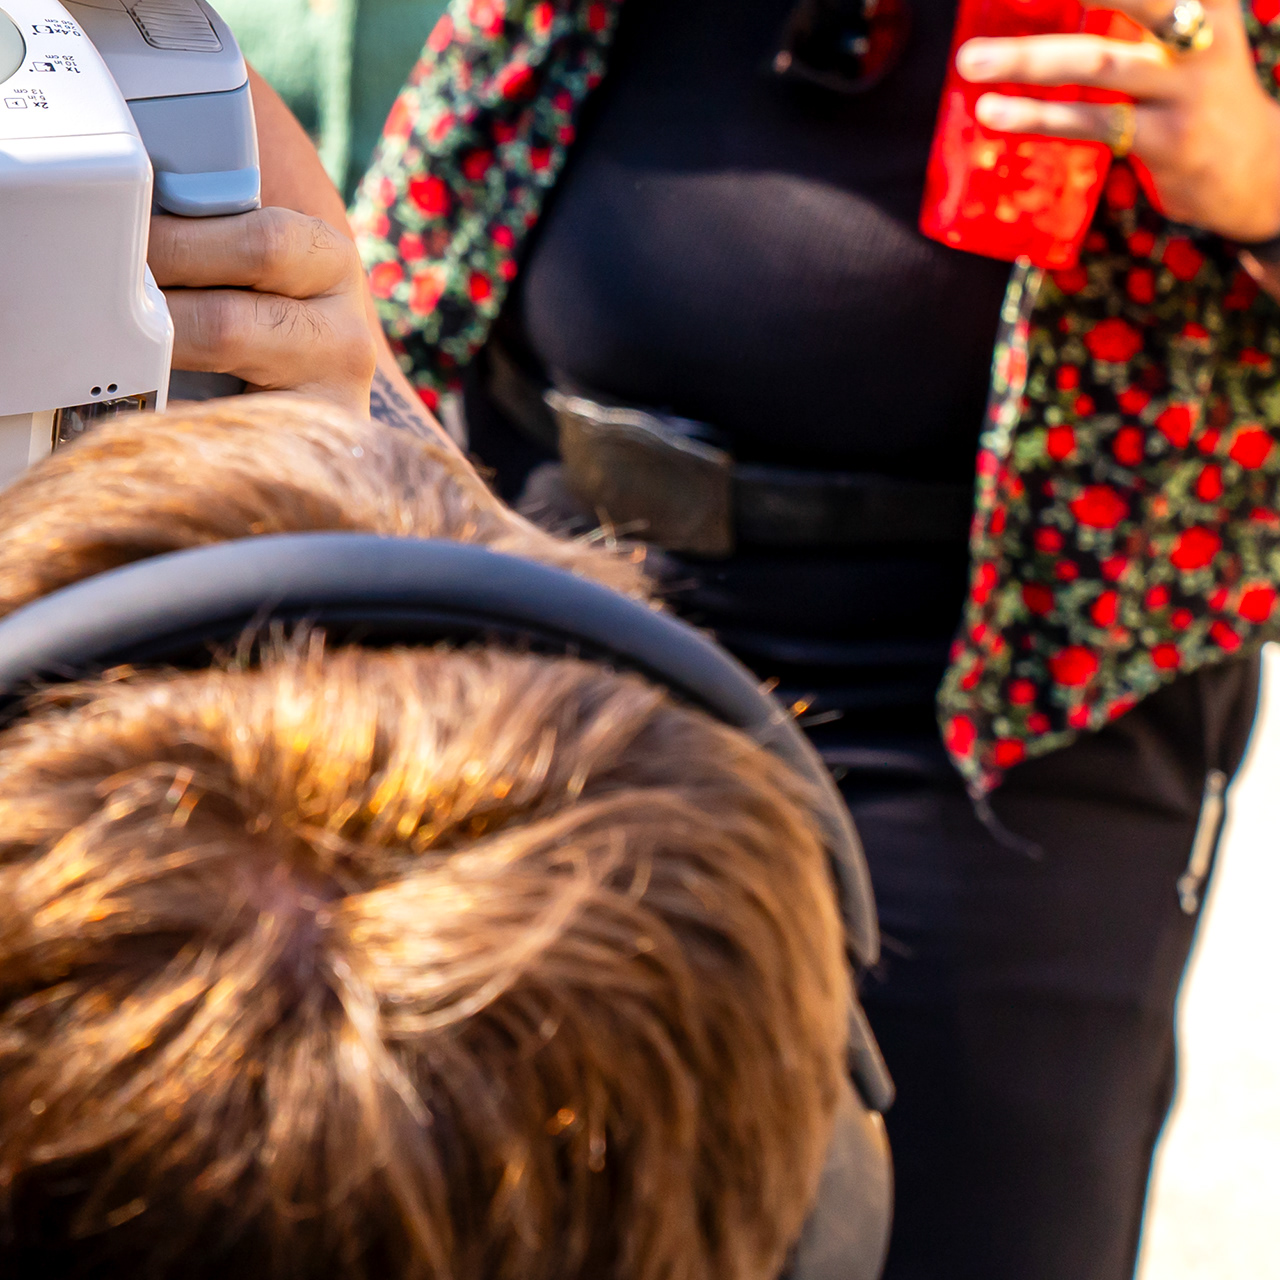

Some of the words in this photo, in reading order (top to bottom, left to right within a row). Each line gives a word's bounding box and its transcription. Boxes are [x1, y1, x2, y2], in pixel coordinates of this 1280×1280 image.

[53, 28, 81, 37] 0.4x
[65, 66, 80, 74] 1x
[33, 101, 49, 110] 2x
